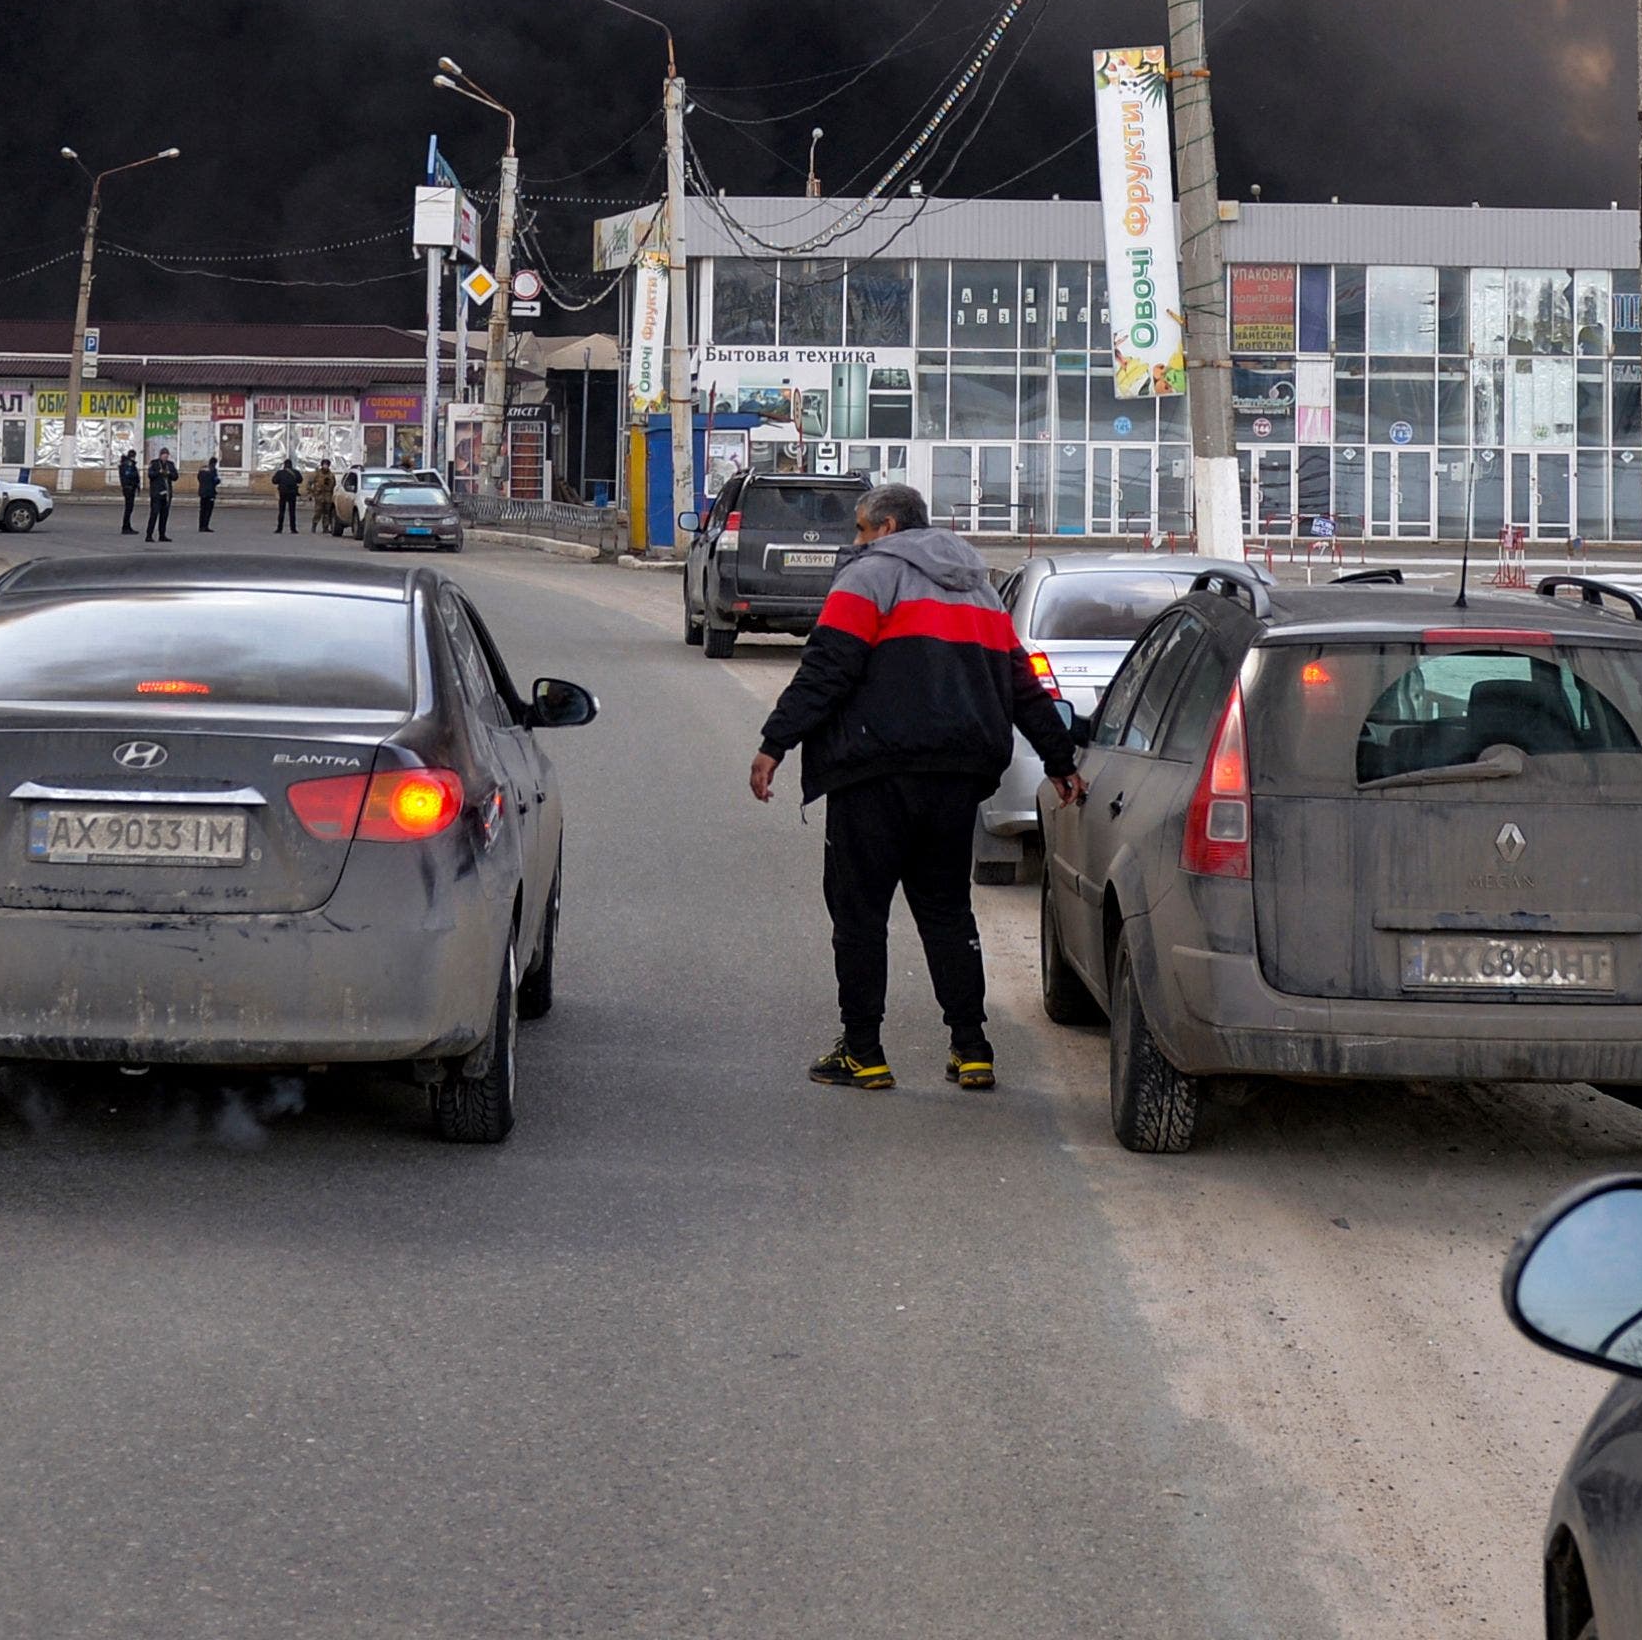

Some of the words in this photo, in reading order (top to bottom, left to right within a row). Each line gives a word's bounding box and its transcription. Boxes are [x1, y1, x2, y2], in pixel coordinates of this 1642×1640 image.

[1121, 100, 1153, 237] Фрукти
[1232, 268, 1294, 281] УПАКОВКА
[1126, 246, 1158, 350] Овочі
[705, 346, 789, 362] Бытовая
[796, 349, 877, 363] техника
[273, 753, 361, 767] ELANTRA
[51, 817, 98, 849] AX
[107, 818, 183, 851] 9033
[193, 820, 233, 853] IM
[1427, 946, 1475, 977] AX
[1481, 948, 1554, 978] 6860
